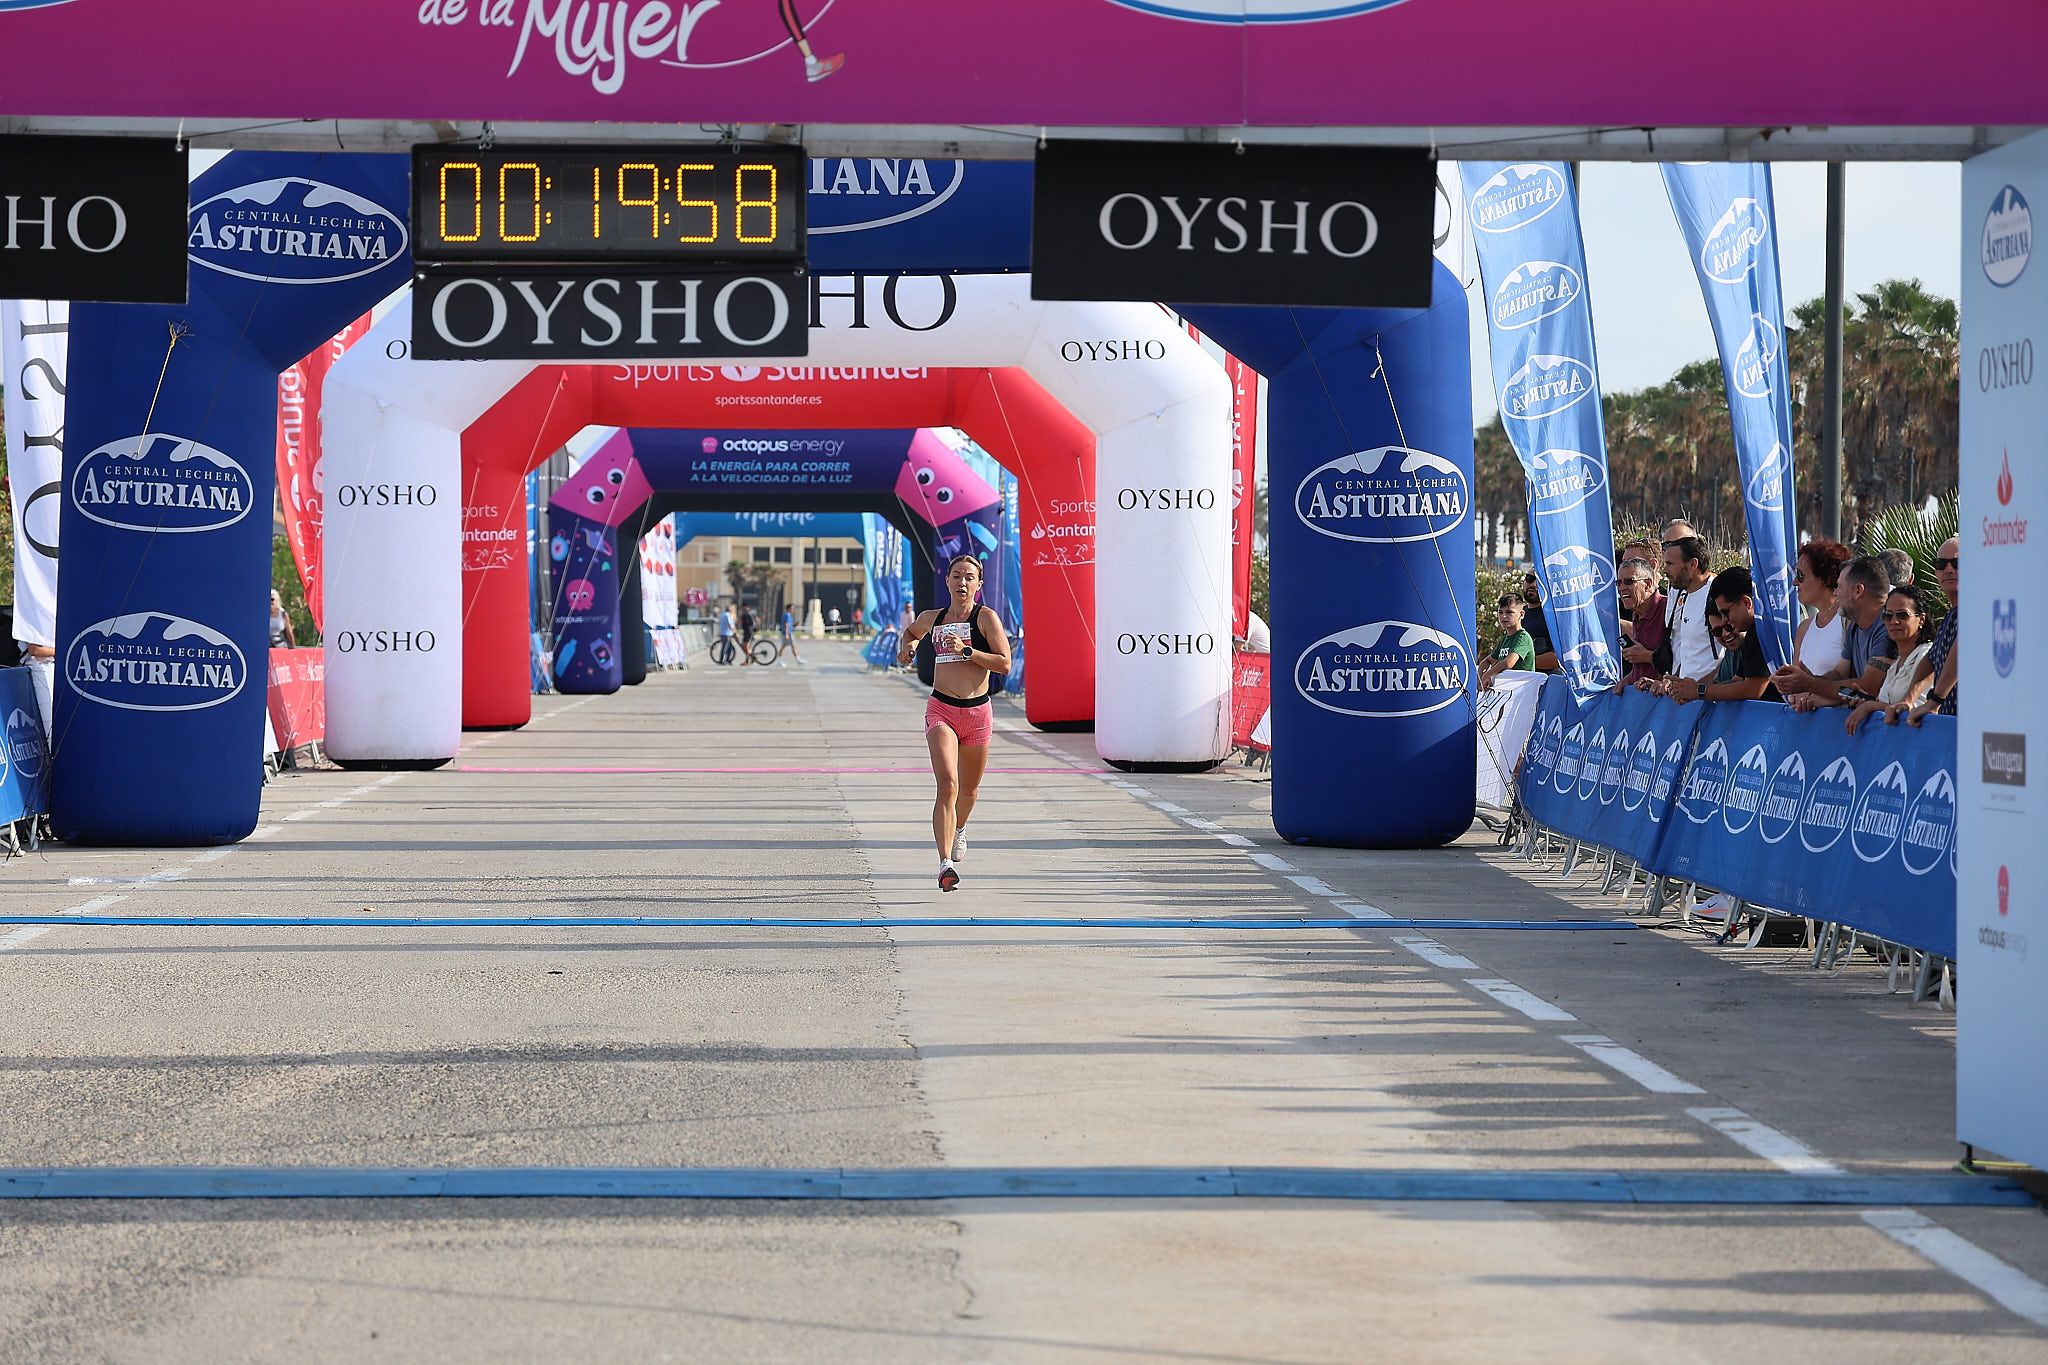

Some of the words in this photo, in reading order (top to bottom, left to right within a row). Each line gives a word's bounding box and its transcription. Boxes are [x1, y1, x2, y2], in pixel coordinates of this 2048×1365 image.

[419, 0, 466, 25] de
[479, 0, 514, 26] la
[507, 0, 721, 94] Mujer
[440, 162, 777, 243] 00:19:58
[224, 210, 301, 225] CENTRAL
[308, 215, 387, 231] LECHERA
[1099, 192, 1379, 258] OYSHO
[188, 212, 388, 260] ASTURIANA
[431, 276, 790, 347] OYSHO
[1061, 339, 1166, 362] OYSHO
[1979, 338, 2033, 393] OYSHO
[715, 394, 822, 407] sportssantander.es
[105, 465, 169, 478] CENTRAL
[175, 468, 239, 483] LECHERA
[691, 461, 707, 471] LA
[710, 459, 762, 471] ENERGÍA
[765, 462, 798, 471] PARA
[801, 462, 850, 472] CORRER
[80, 467, 243, 512] ASTURIANA
[690, 474, 699, 482] A
[702, 474, 718, 482] LA
[720, 474, 789, 483] VELOCIDAD
[792, 474, 809, 483] DE
[811, 474, 827, 483] LA
[829, 474, 852, 483] LUZ
[1335, 479, 1400, 489] CENTRAL
[1406, 477, 1458, 489] LECHERA
[338, 484, 437, 507] OYSHO
[1117, 488, 1215, 510] OYSHO
[1306, 482, 1462, 518] ASTURIANA
[1050, 499, 1096, 516] Sports
[1982, 514, 2028, 547] Santander
[98, 643, 162, 657] CENTRAL
[168, 646, 232, 660] LECHERA
[337, 630, 436, 653] OYSHO
[1117, 633, 1214, 655] OYSHO
[73, 645, 236, 689] ASTURIANA
[1334, 654, 1399, 664] CENTRAL
[1404, 651, 1458, 663] LECHERA
[1305, 656, 1461, 692] ASTURIANA
[1983, 743, 2024, 780] Neutrogena
